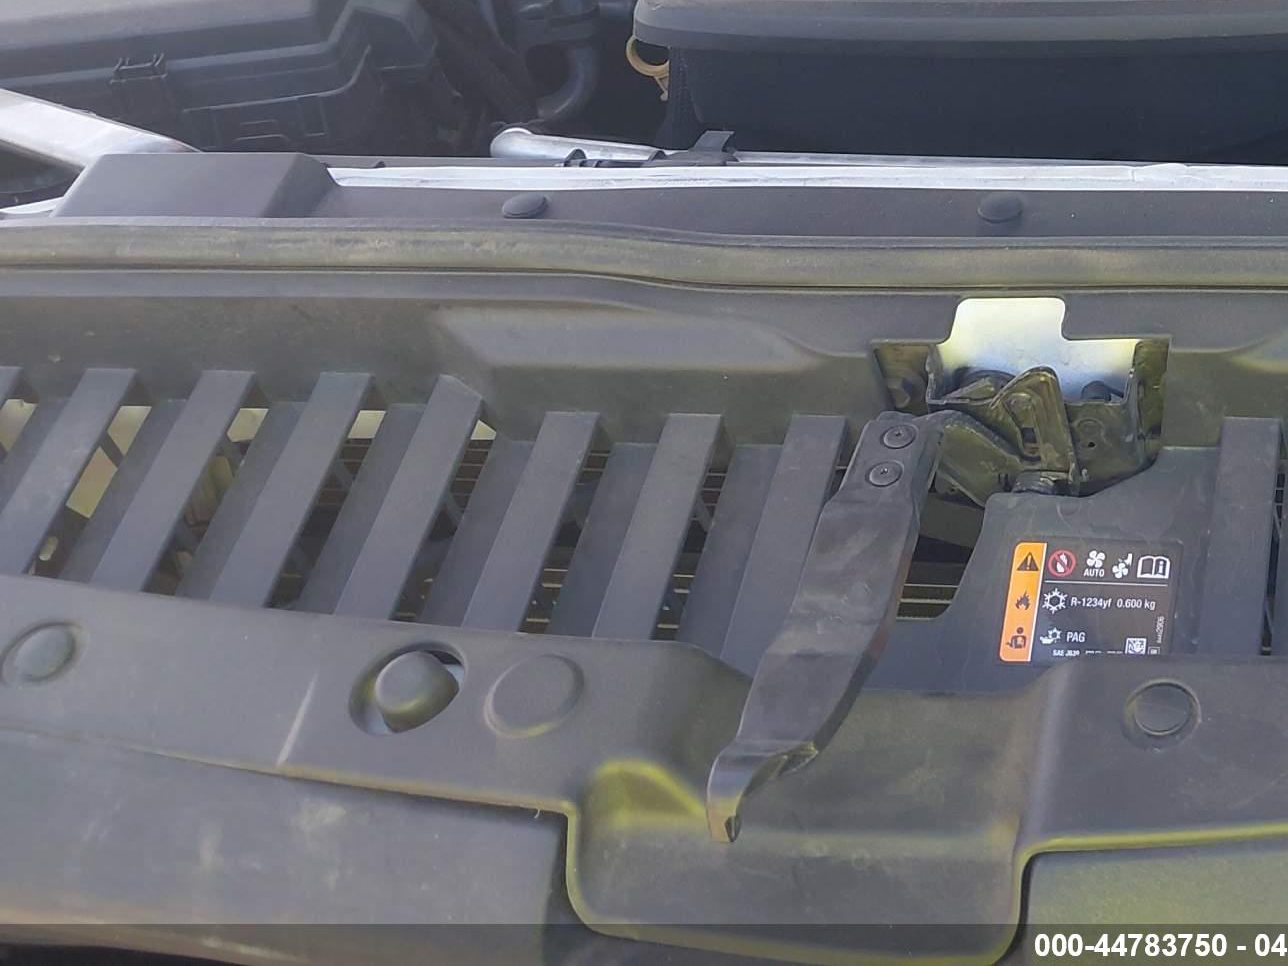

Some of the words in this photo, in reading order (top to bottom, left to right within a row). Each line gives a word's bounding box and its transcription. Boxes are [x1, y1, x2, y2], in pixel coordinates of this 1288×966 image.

[1083, 568, 1105, 578] AUTO
[1070, 596, 1112, 609] R-1234yf
[1116, 598, 1142, 609] 0.600
[1144, 599, 1156, 611] kg
[1066, 631, 1086, 643] PAG
